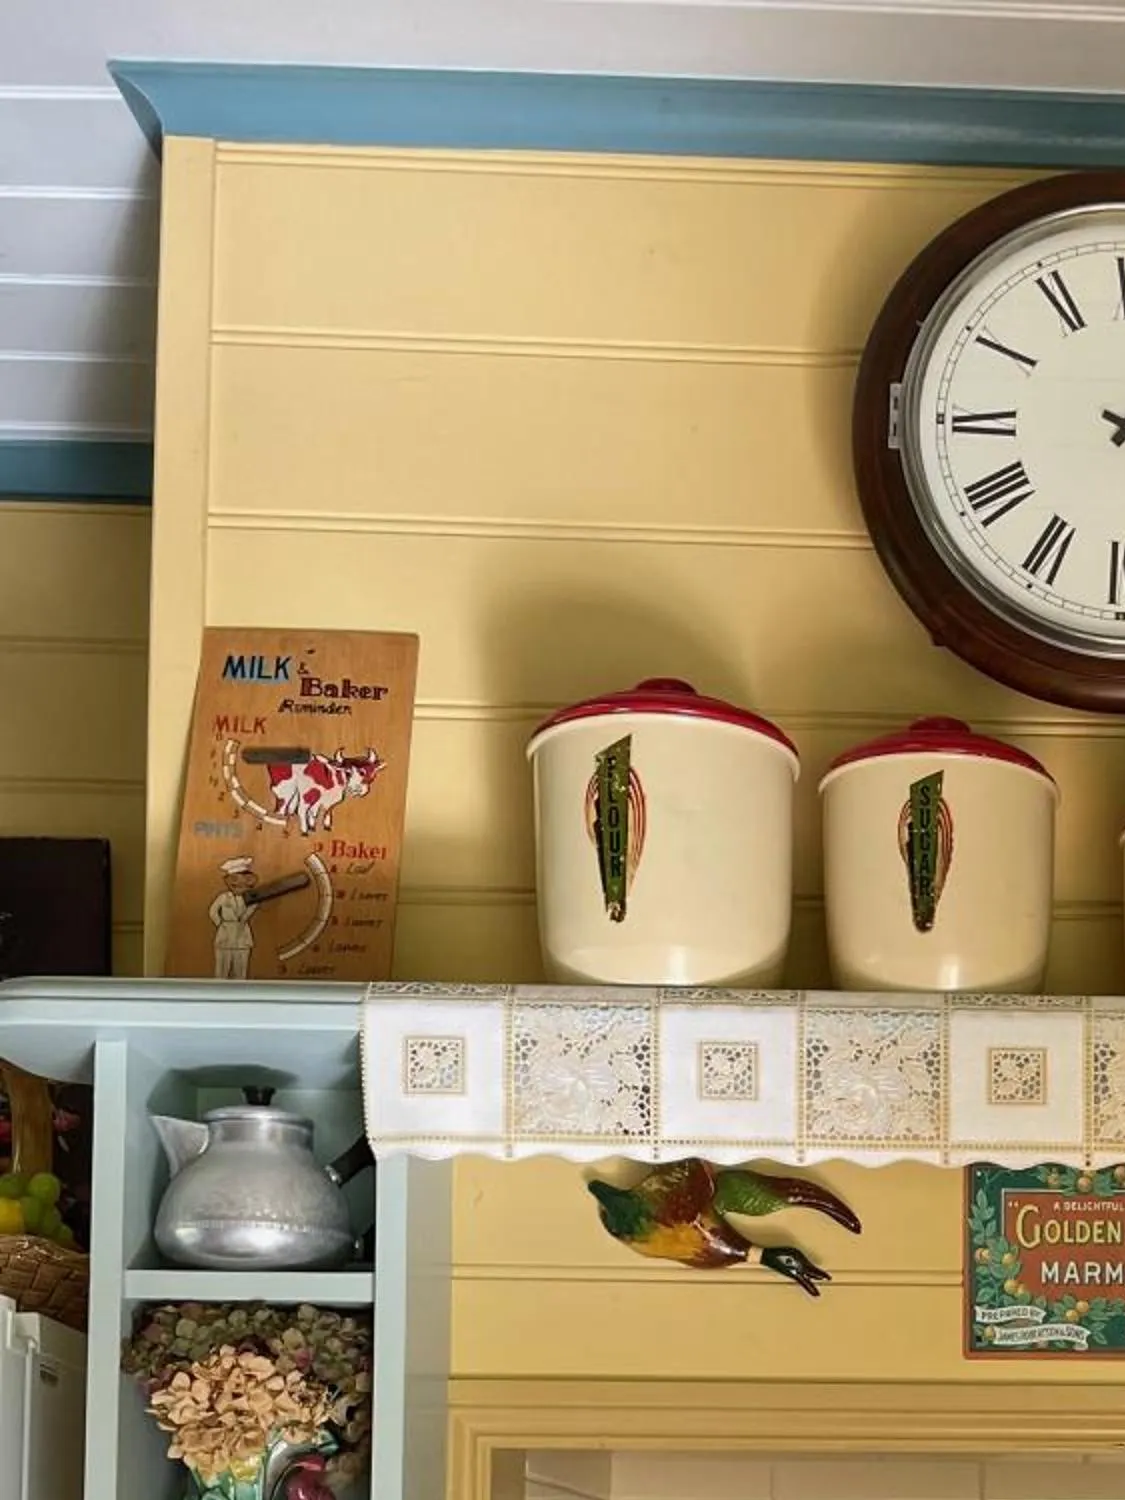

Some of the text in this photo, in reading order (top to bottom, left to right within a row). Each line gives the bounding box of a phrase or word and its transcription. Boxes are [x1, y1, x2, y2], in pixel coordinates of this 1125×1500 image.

[1034, 269, 1087, 338] XI
[952, 403, 1017, 437] IX
[963, 459, 1037, 528] VIII
[1021, 513, 1077, 586] VII
[222, 655, 292, 680] MILK
[300, 677, 389, 701] Baker
[213, 715, 268, 735] MILK
[330, 839, 388, 861] Baker
